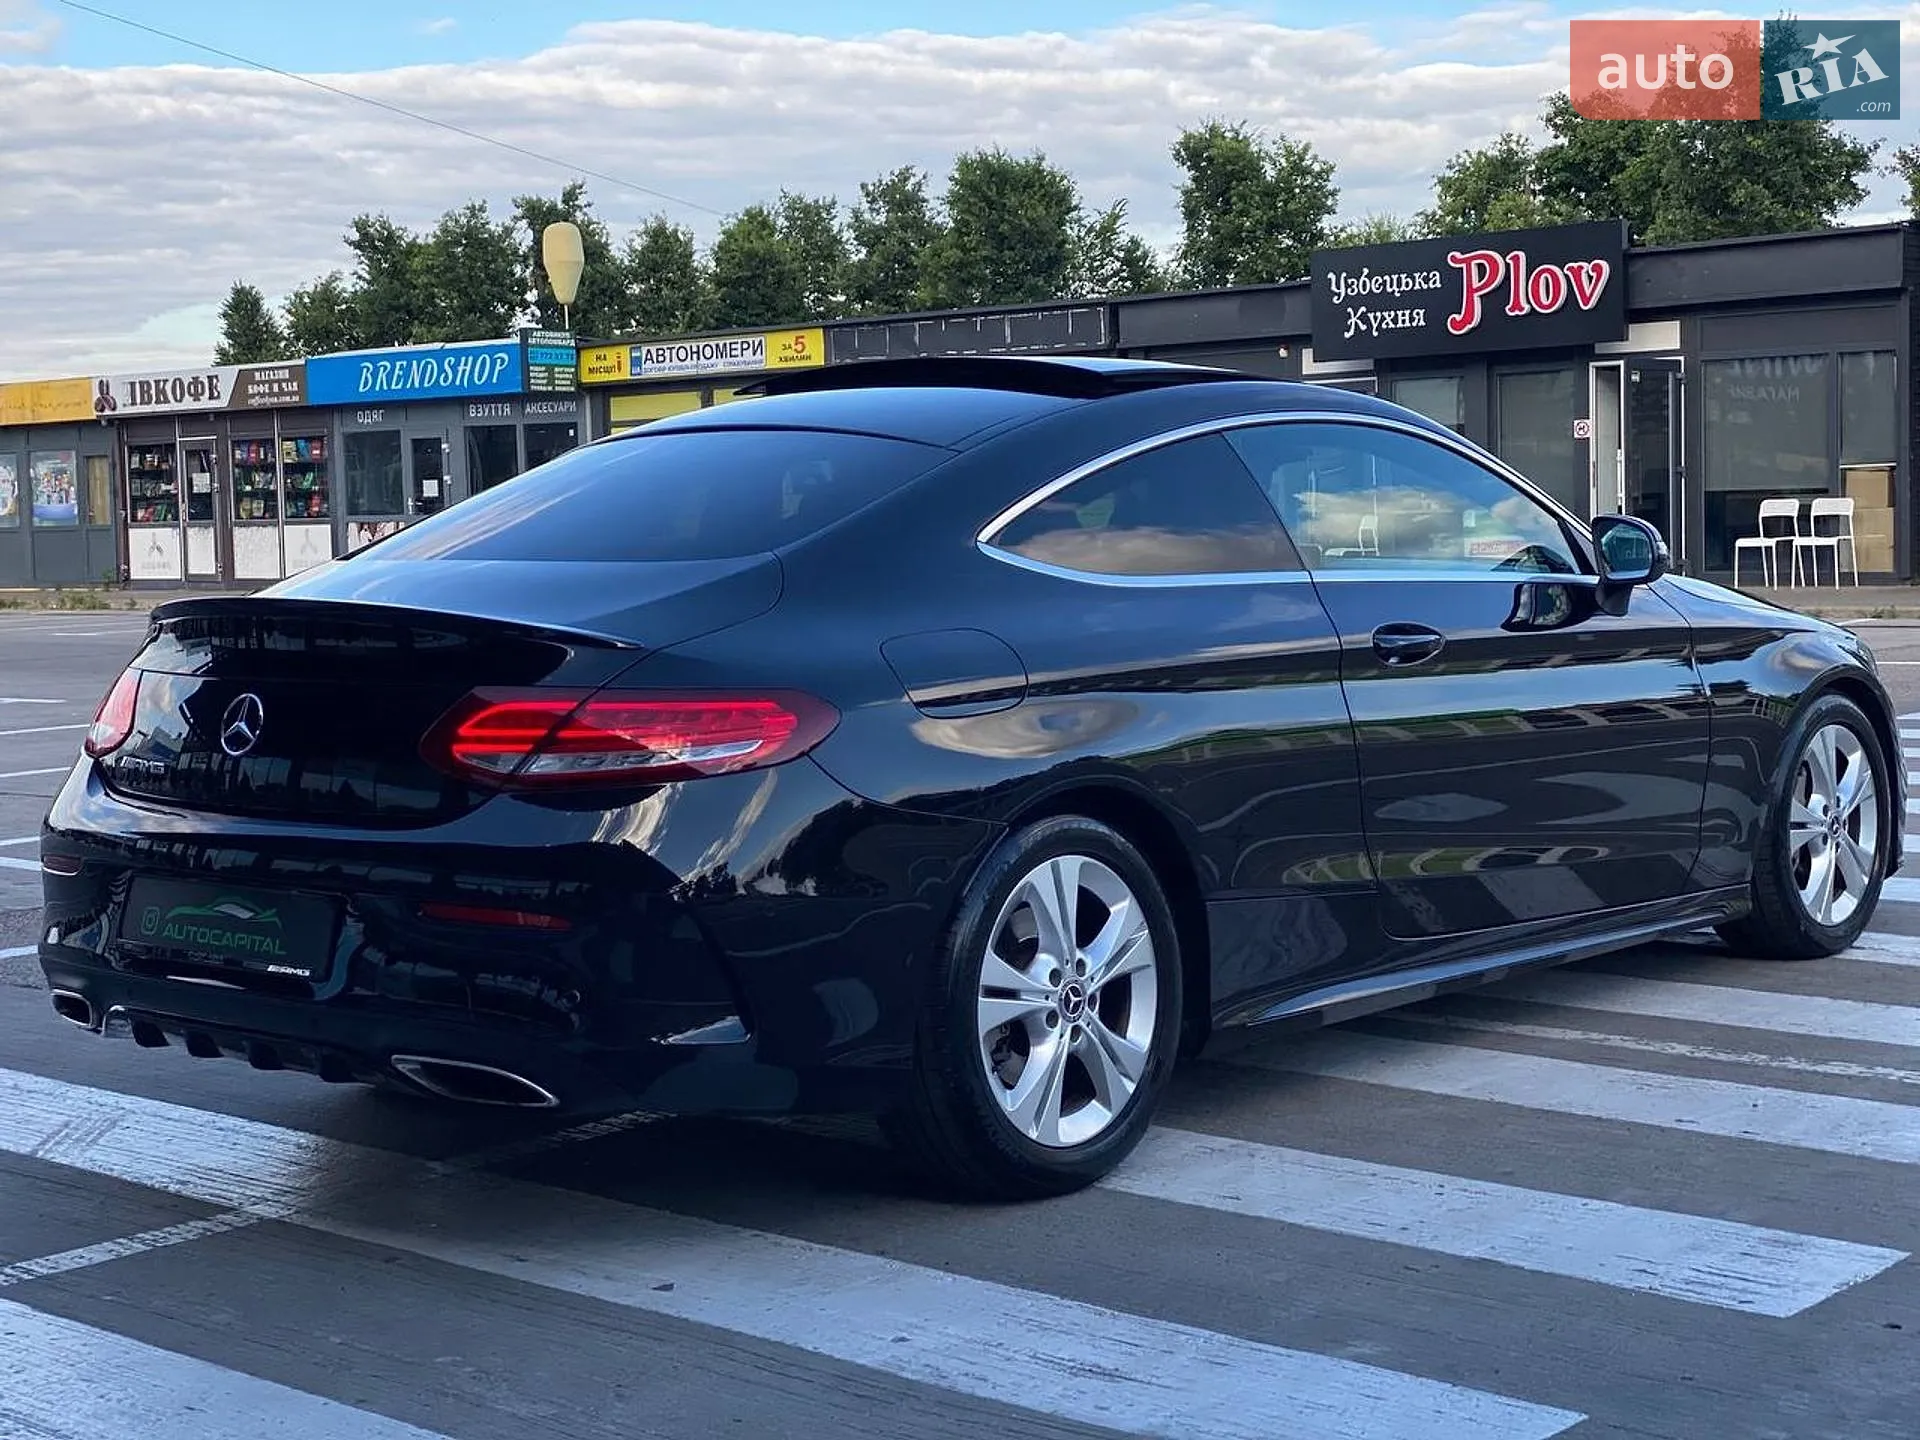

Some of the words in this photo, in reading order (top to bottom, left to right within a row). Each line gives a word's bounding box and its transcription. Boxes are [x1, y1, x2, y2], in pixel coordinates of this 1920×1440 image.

[1327, 267, 1443, 303] Узбецька
[1446, 249, 1611, 335] Plov
[1343, 305, 1427, 339] Кухня
[595, 353, 607, 362] НА
[643, 338, 764, 365] АВТОНОМЕРИ
[781, 343, 793, 351] ЗА
[793, 334, 806, 354] 5
[358, 352, 510, 393] BRENDSHOP
[357, 408, 385, 424] ОДЯГ
[469, 401, 512, 418] ВЗУТТЯ
[525, 399, 577, 414] АКСЕСУАРИ
[162, 922, 288, 956] AUTOCAPITAL
